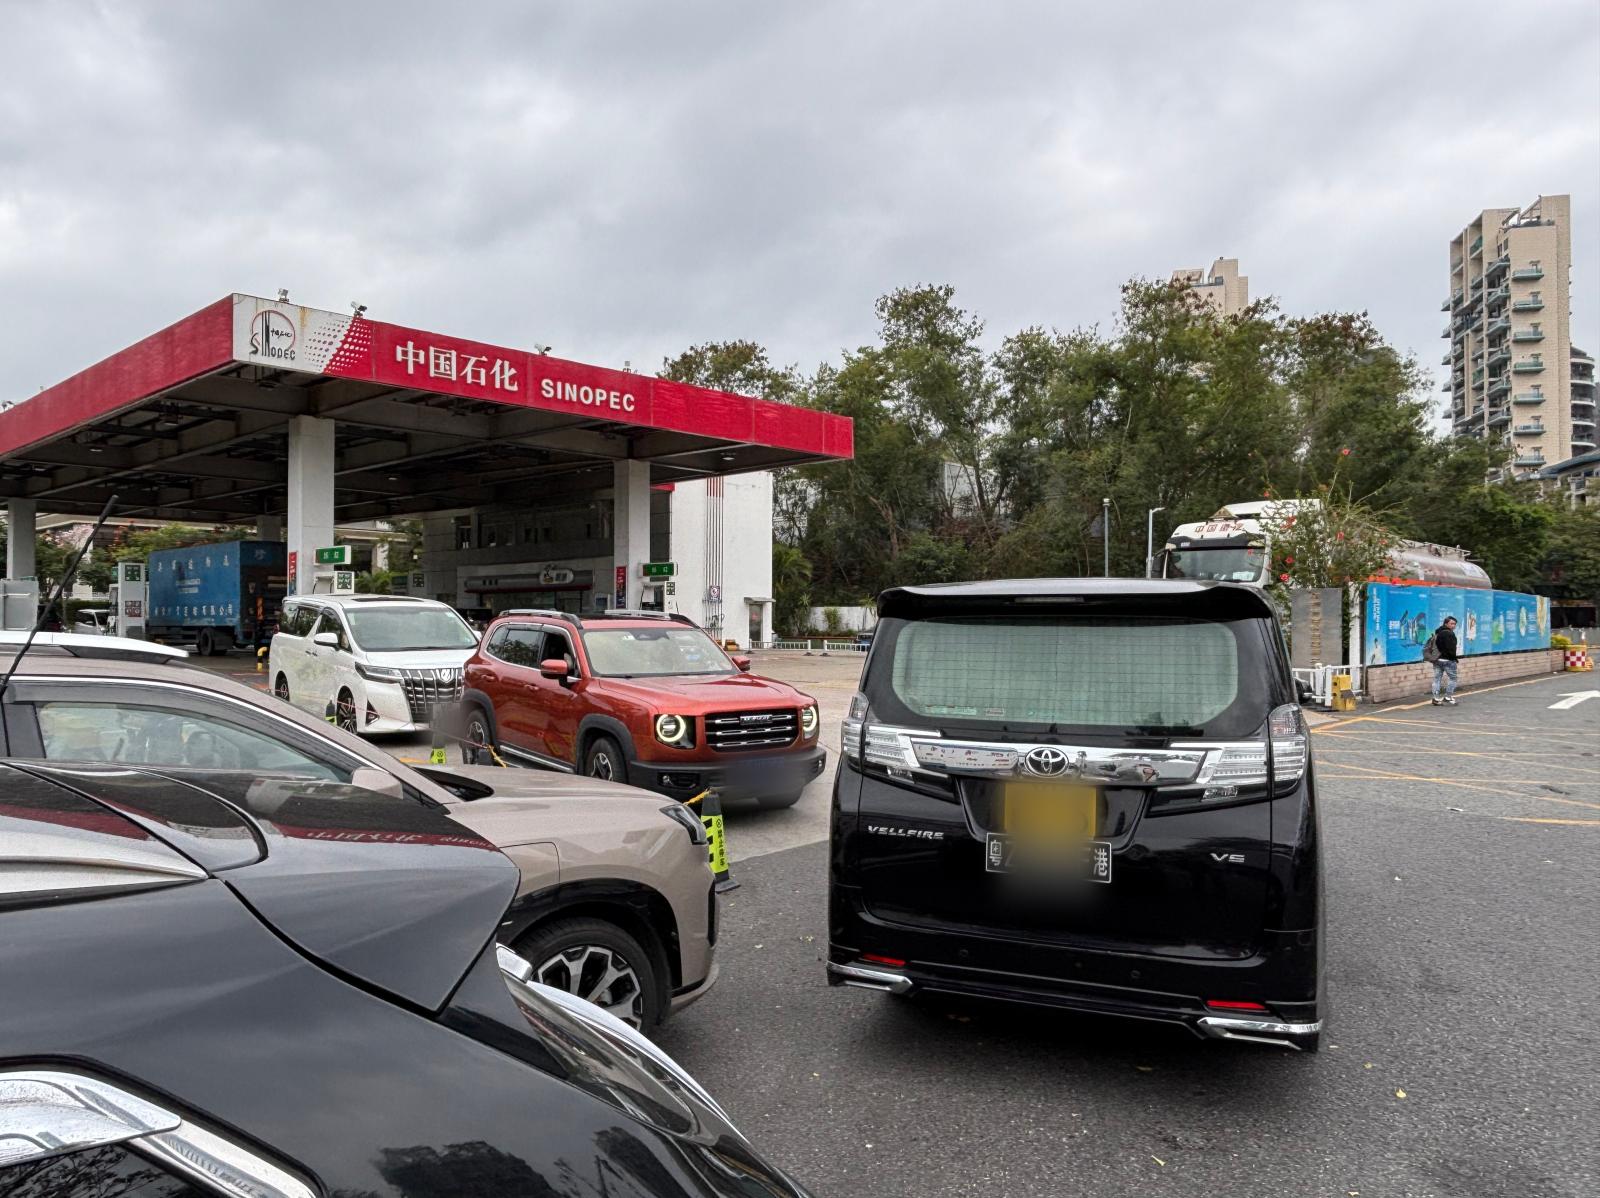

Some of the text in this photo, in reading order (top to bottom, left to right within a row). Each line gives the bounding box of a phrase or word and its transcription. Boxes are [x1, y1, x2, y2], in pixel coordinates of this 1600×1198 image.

[395, 340, 519, 392] 中国石化
[541, 379, 636, 412] SINOPEC
[867, 825, 945, 840] VELLFIRE
